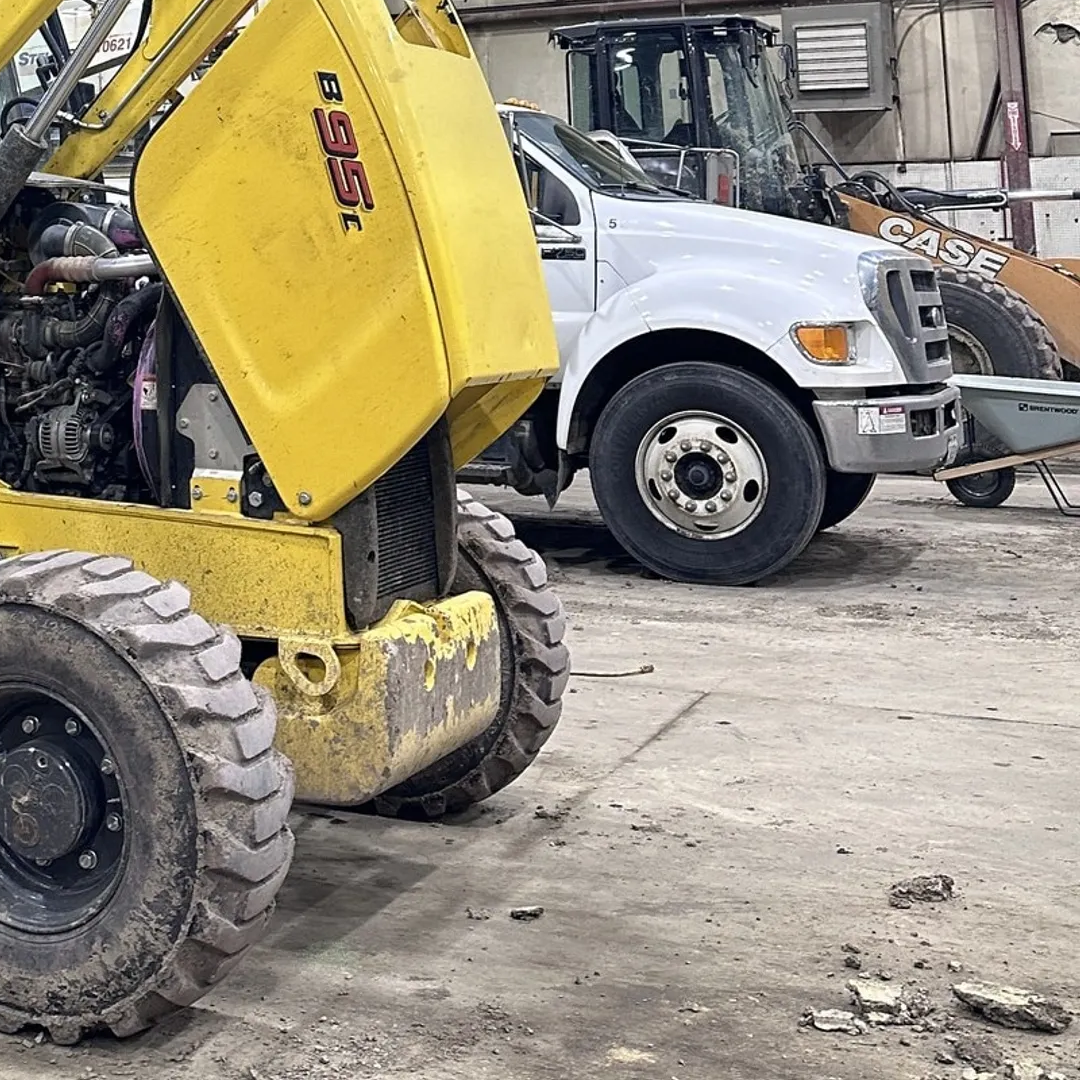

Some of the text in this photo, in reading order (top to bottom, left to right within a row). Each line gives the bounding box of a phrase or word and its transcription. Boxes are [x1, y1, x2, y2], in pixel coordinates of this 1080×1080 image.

[608, 218, 617, 229] 5
[878, 215, 1009, 279] CASE
[1029, 405, 1078, 415] BRENTWOOD
